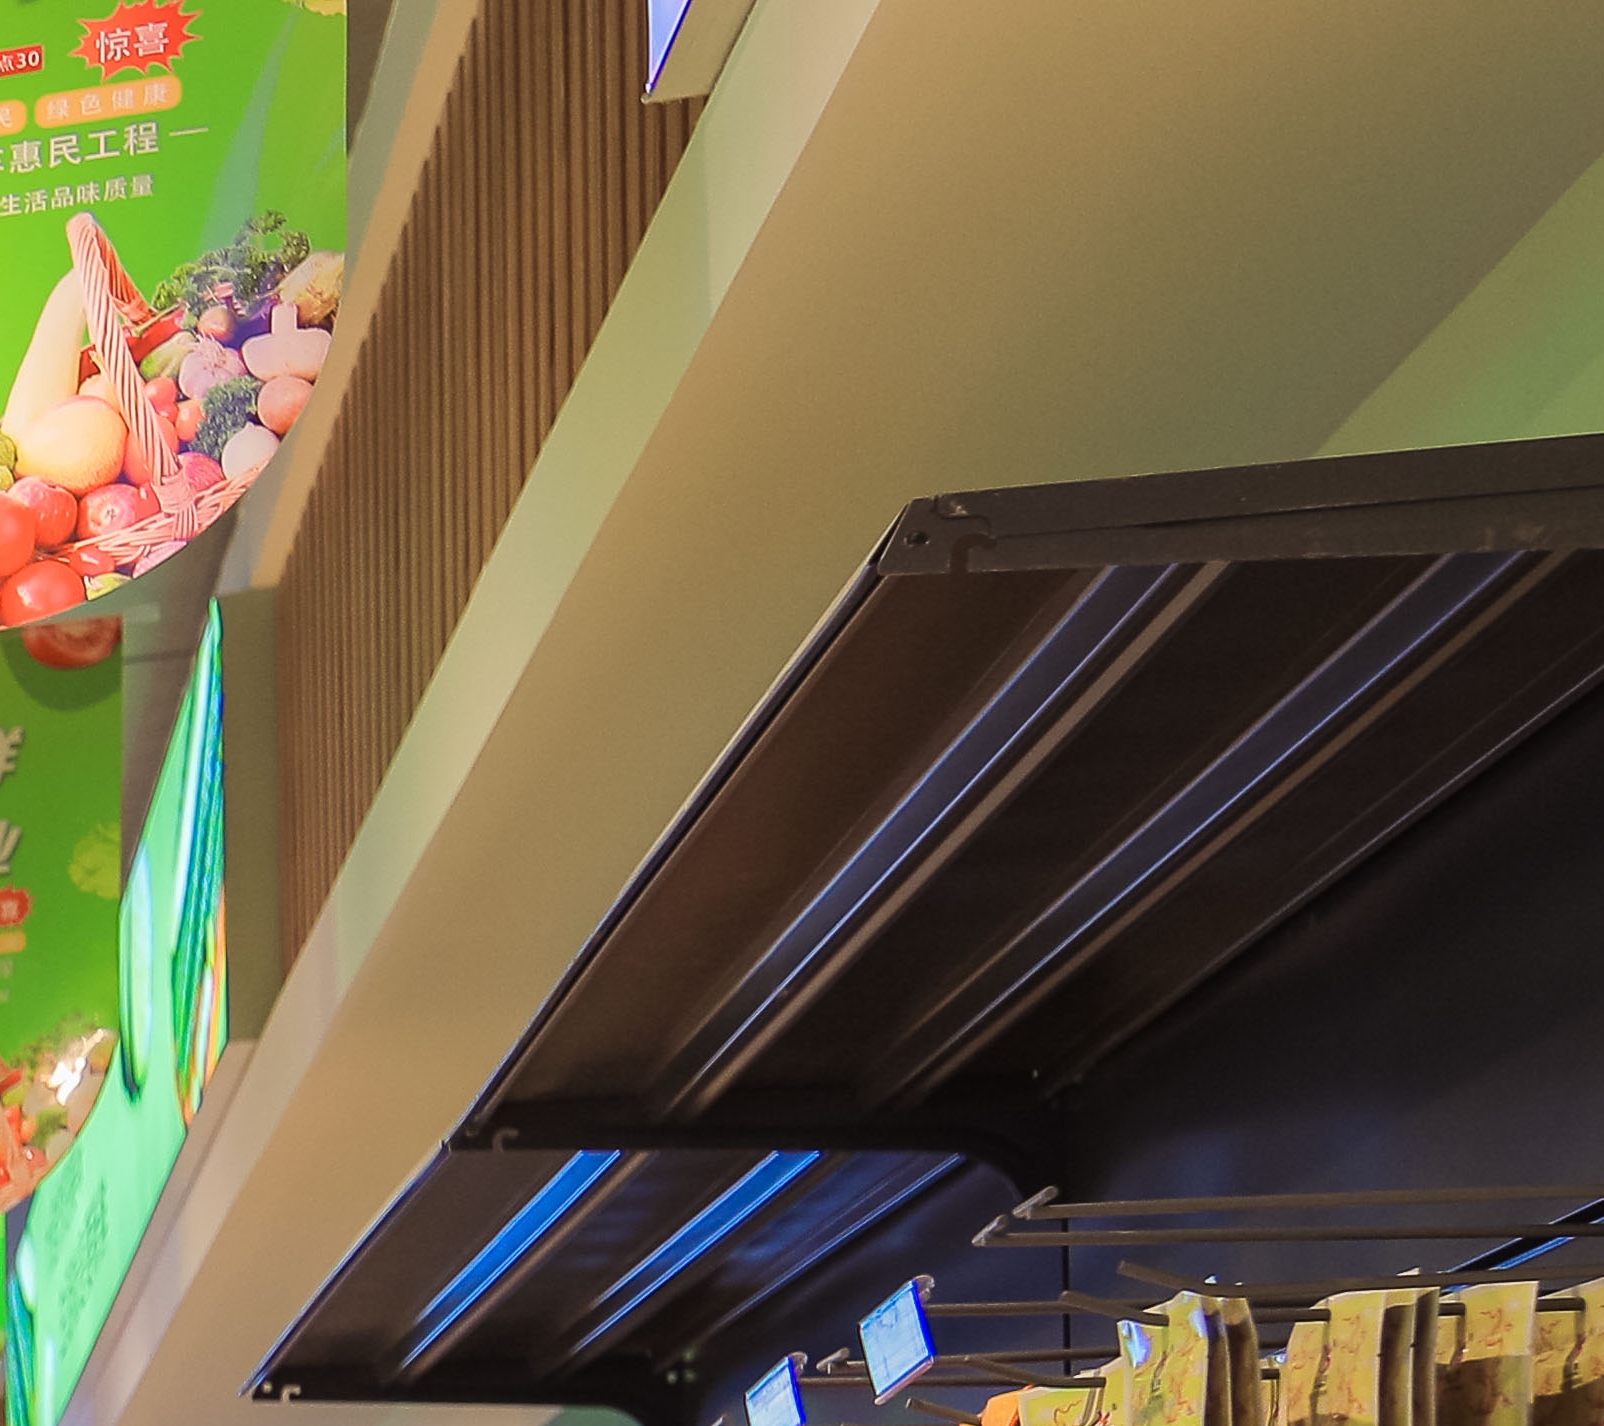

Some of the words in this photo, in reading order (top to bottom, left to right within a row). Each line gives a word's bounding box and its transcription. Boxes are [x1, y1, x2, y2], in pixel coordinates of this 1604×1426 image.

[96, 22, 169, 64] 惊喜
[47, 82, 168, 121] 绿色健康
